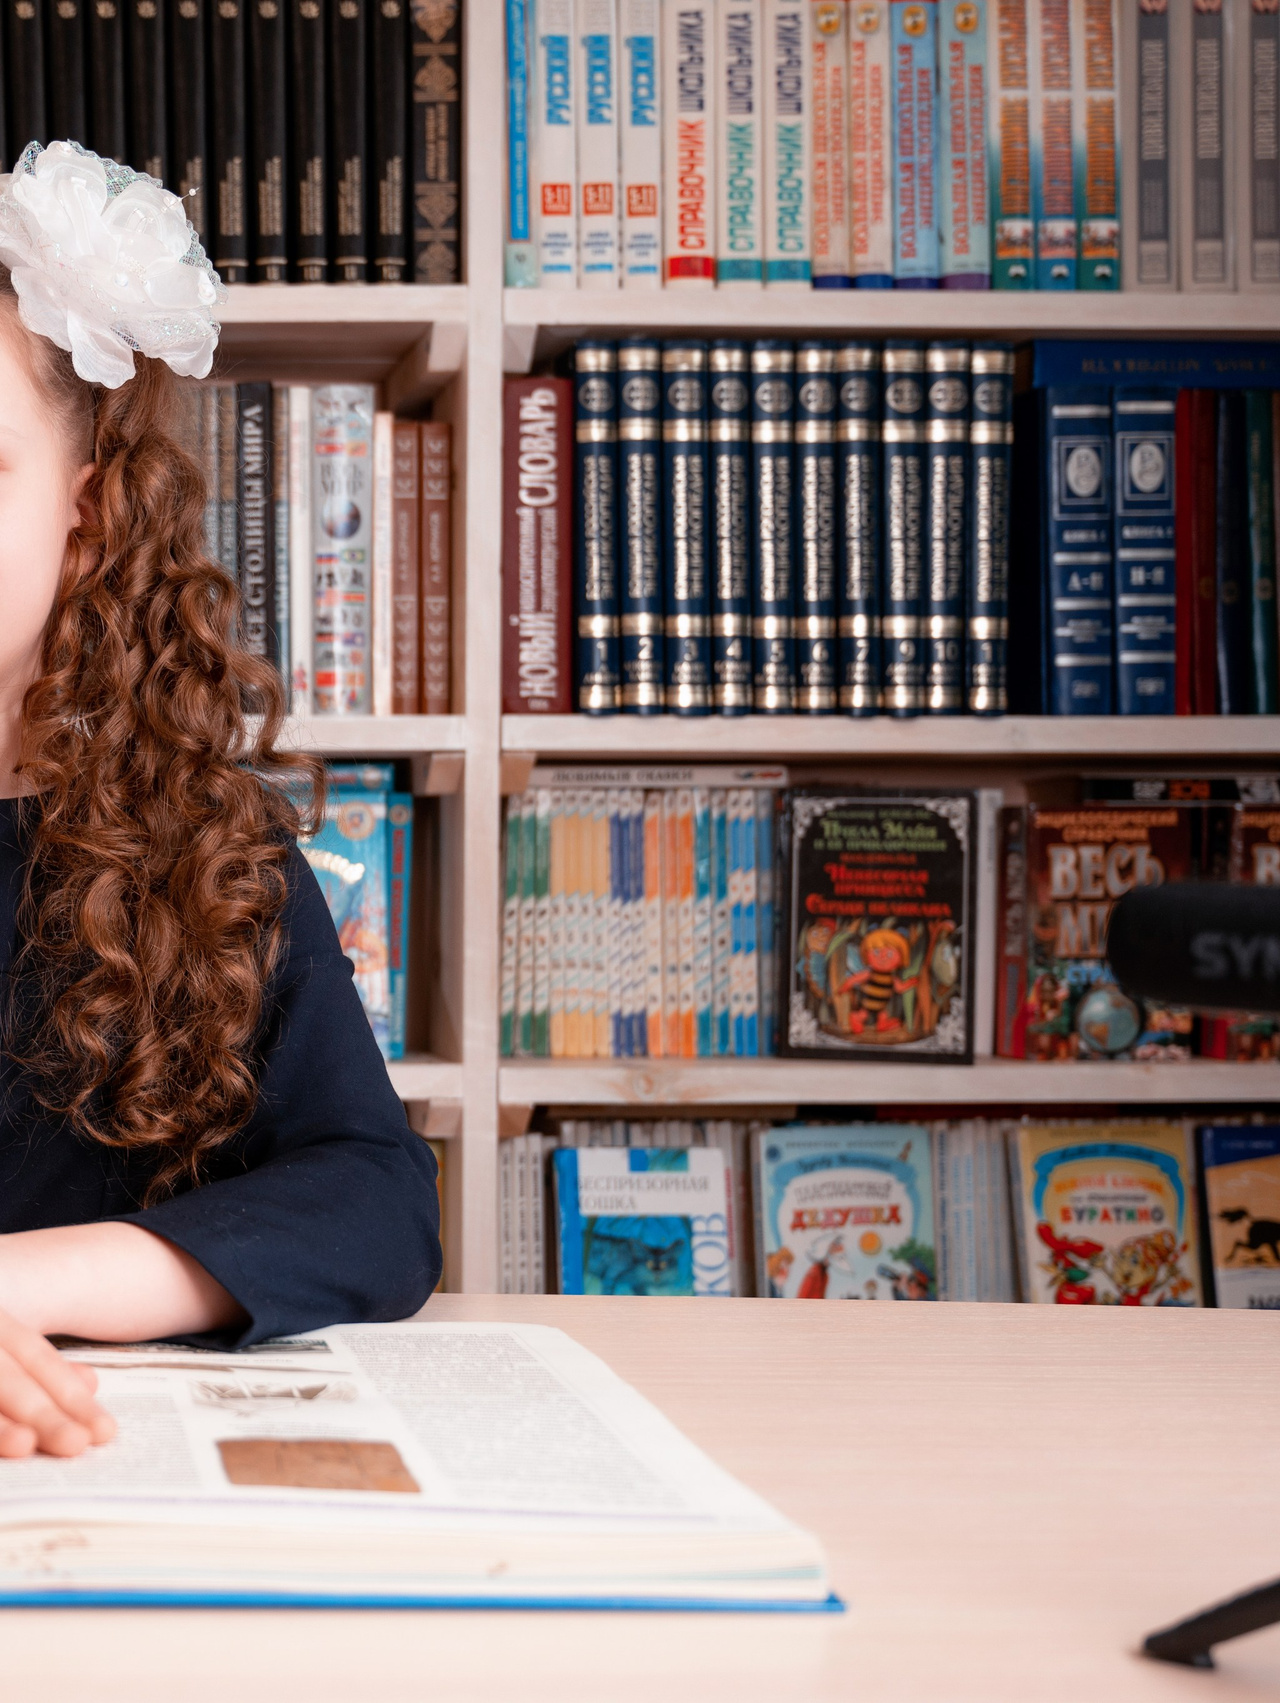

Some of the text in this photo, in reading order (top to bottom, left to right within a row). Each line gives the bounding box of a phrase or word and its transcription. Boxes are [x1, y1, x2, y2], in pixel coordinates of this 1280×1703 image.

[677, 10, 705, 249] СПРАВОЧНИК ШКОЛЬНИКА
[726, 12, 755, 251] СПРАВОЧНИК ШКОЛЬНИКА
[774, 13, 803, 252] СПРАВОЧНИК ШКОЛЬНИКА
[242, 404, 263, 475] МИРА
[243, 478, 267, 606] СТОЛИЦЫ
[510, 388, 558, 698] НОВЫЙ СЛОВАРЬ
[596, 639, 607, 662] 1
[638, 637, 654, 661] 2
[684, 639, 698, 662] 3
[726, 638, 742, 660] 4
[770, 640, 785, 663] 5
[812, 640, 828, 663] 6
[856, 639, 871, 662] 7
[899, 640, 915, 663] 9
[934, 639, 959, 662] 10
[1047, 842, 1165, 899] ВЕСЬ
[1054, 901, 1118, 959] МИ
[791, 1204, 902, 1230] ДЕДУШКА
[1060, 1206, 1164, 1226] БУРАТИНО
